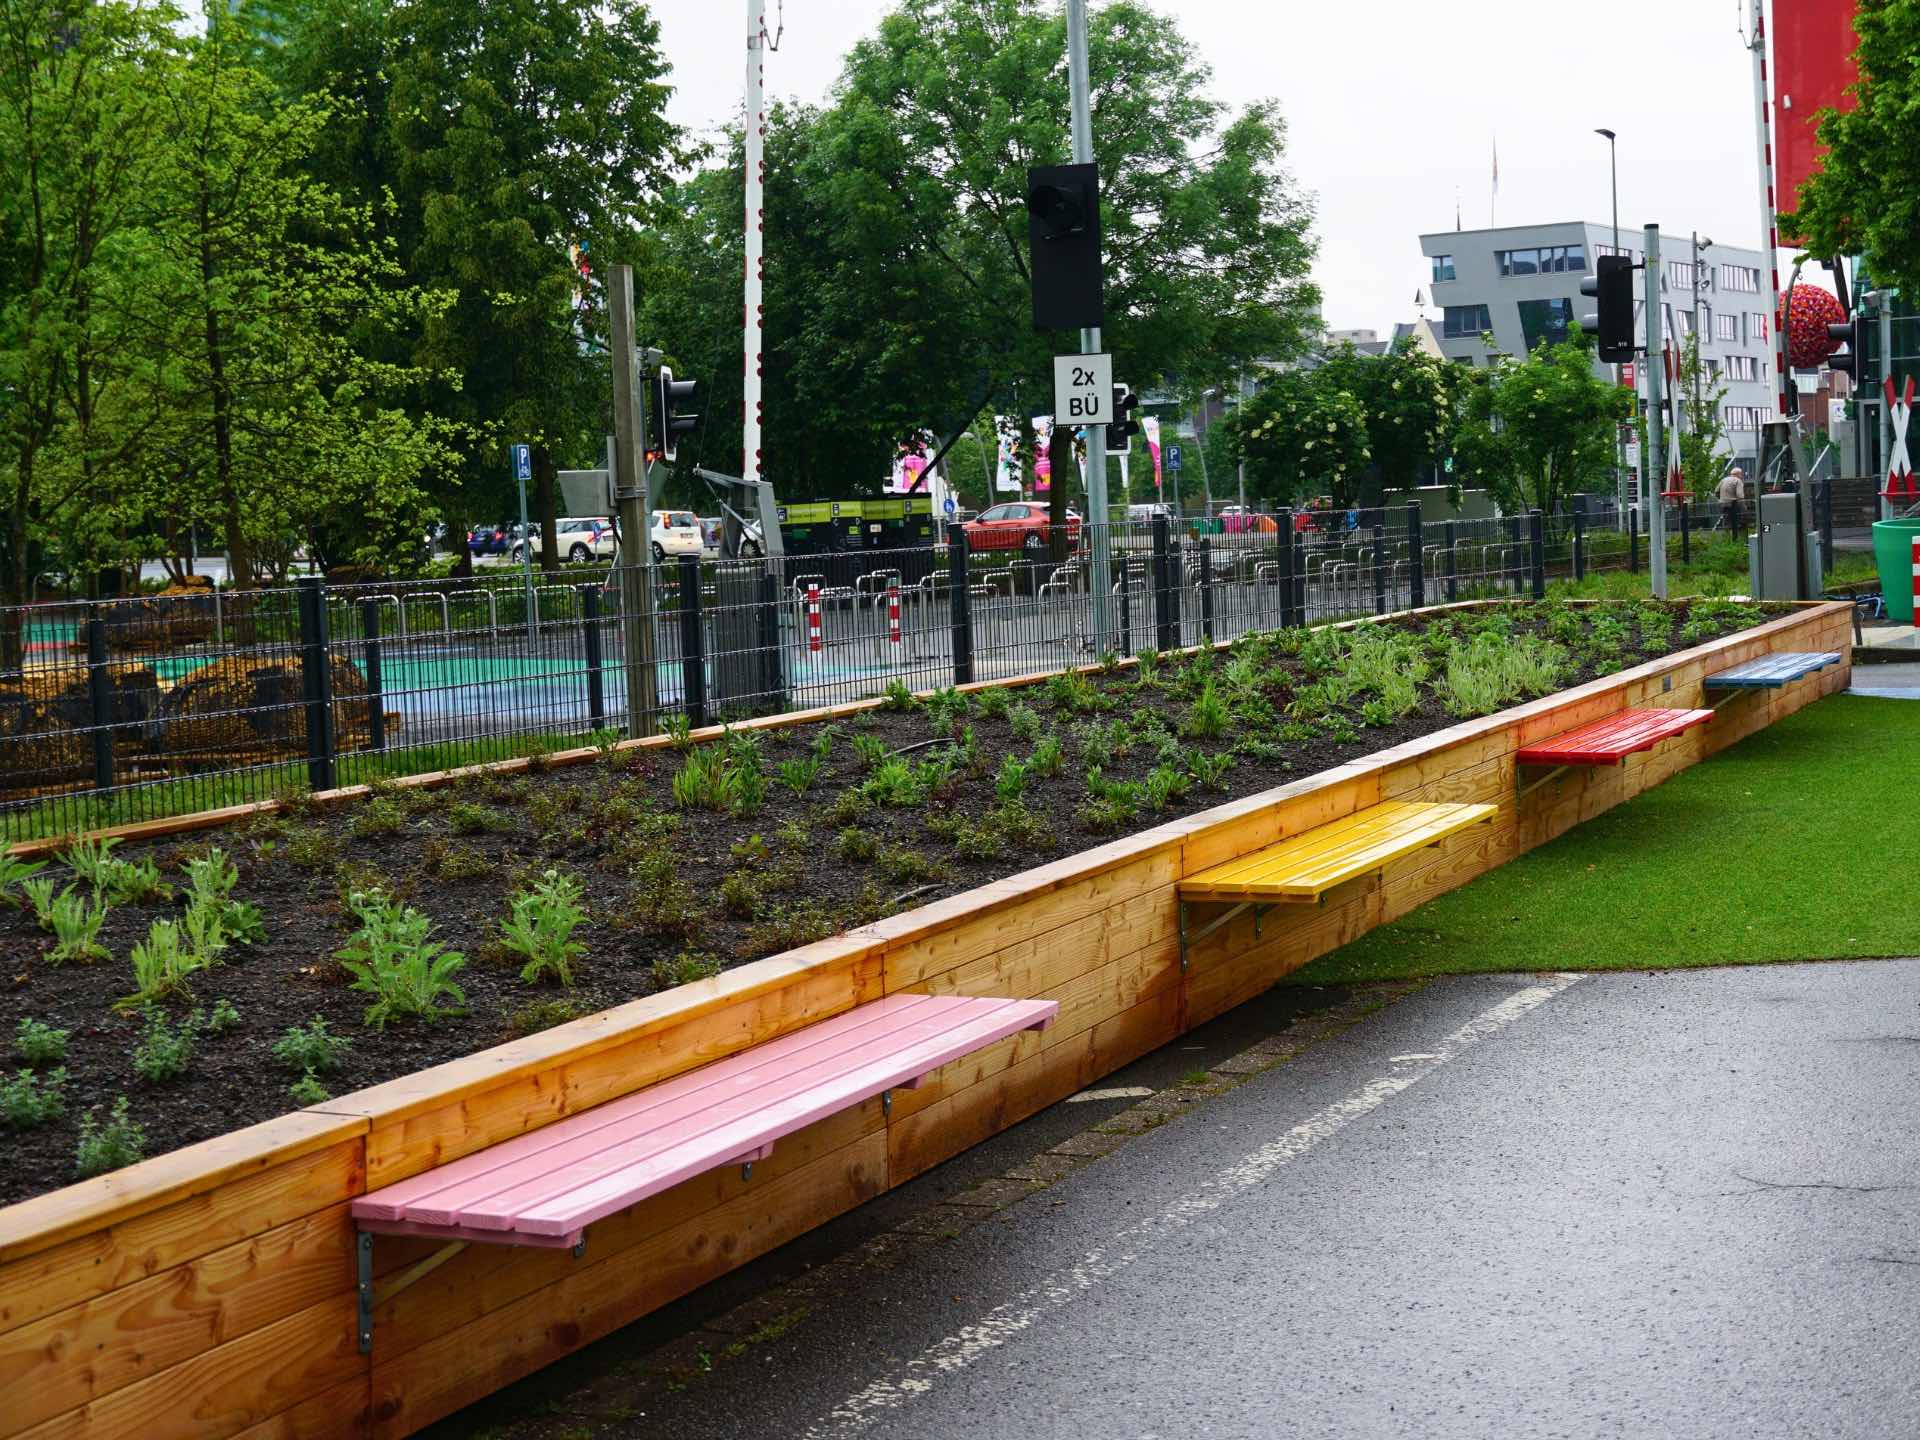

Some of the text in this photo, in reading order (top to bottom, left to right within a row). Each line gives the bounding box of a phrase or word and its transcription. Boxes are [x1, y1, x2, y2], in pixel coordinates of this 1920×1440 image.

[1072, 367, 1095, 386] 2x
[1069, 392, 1099, 416] BÜ
[520, 448, 527, 464] P
[1170, 448, 1178, 460] P
